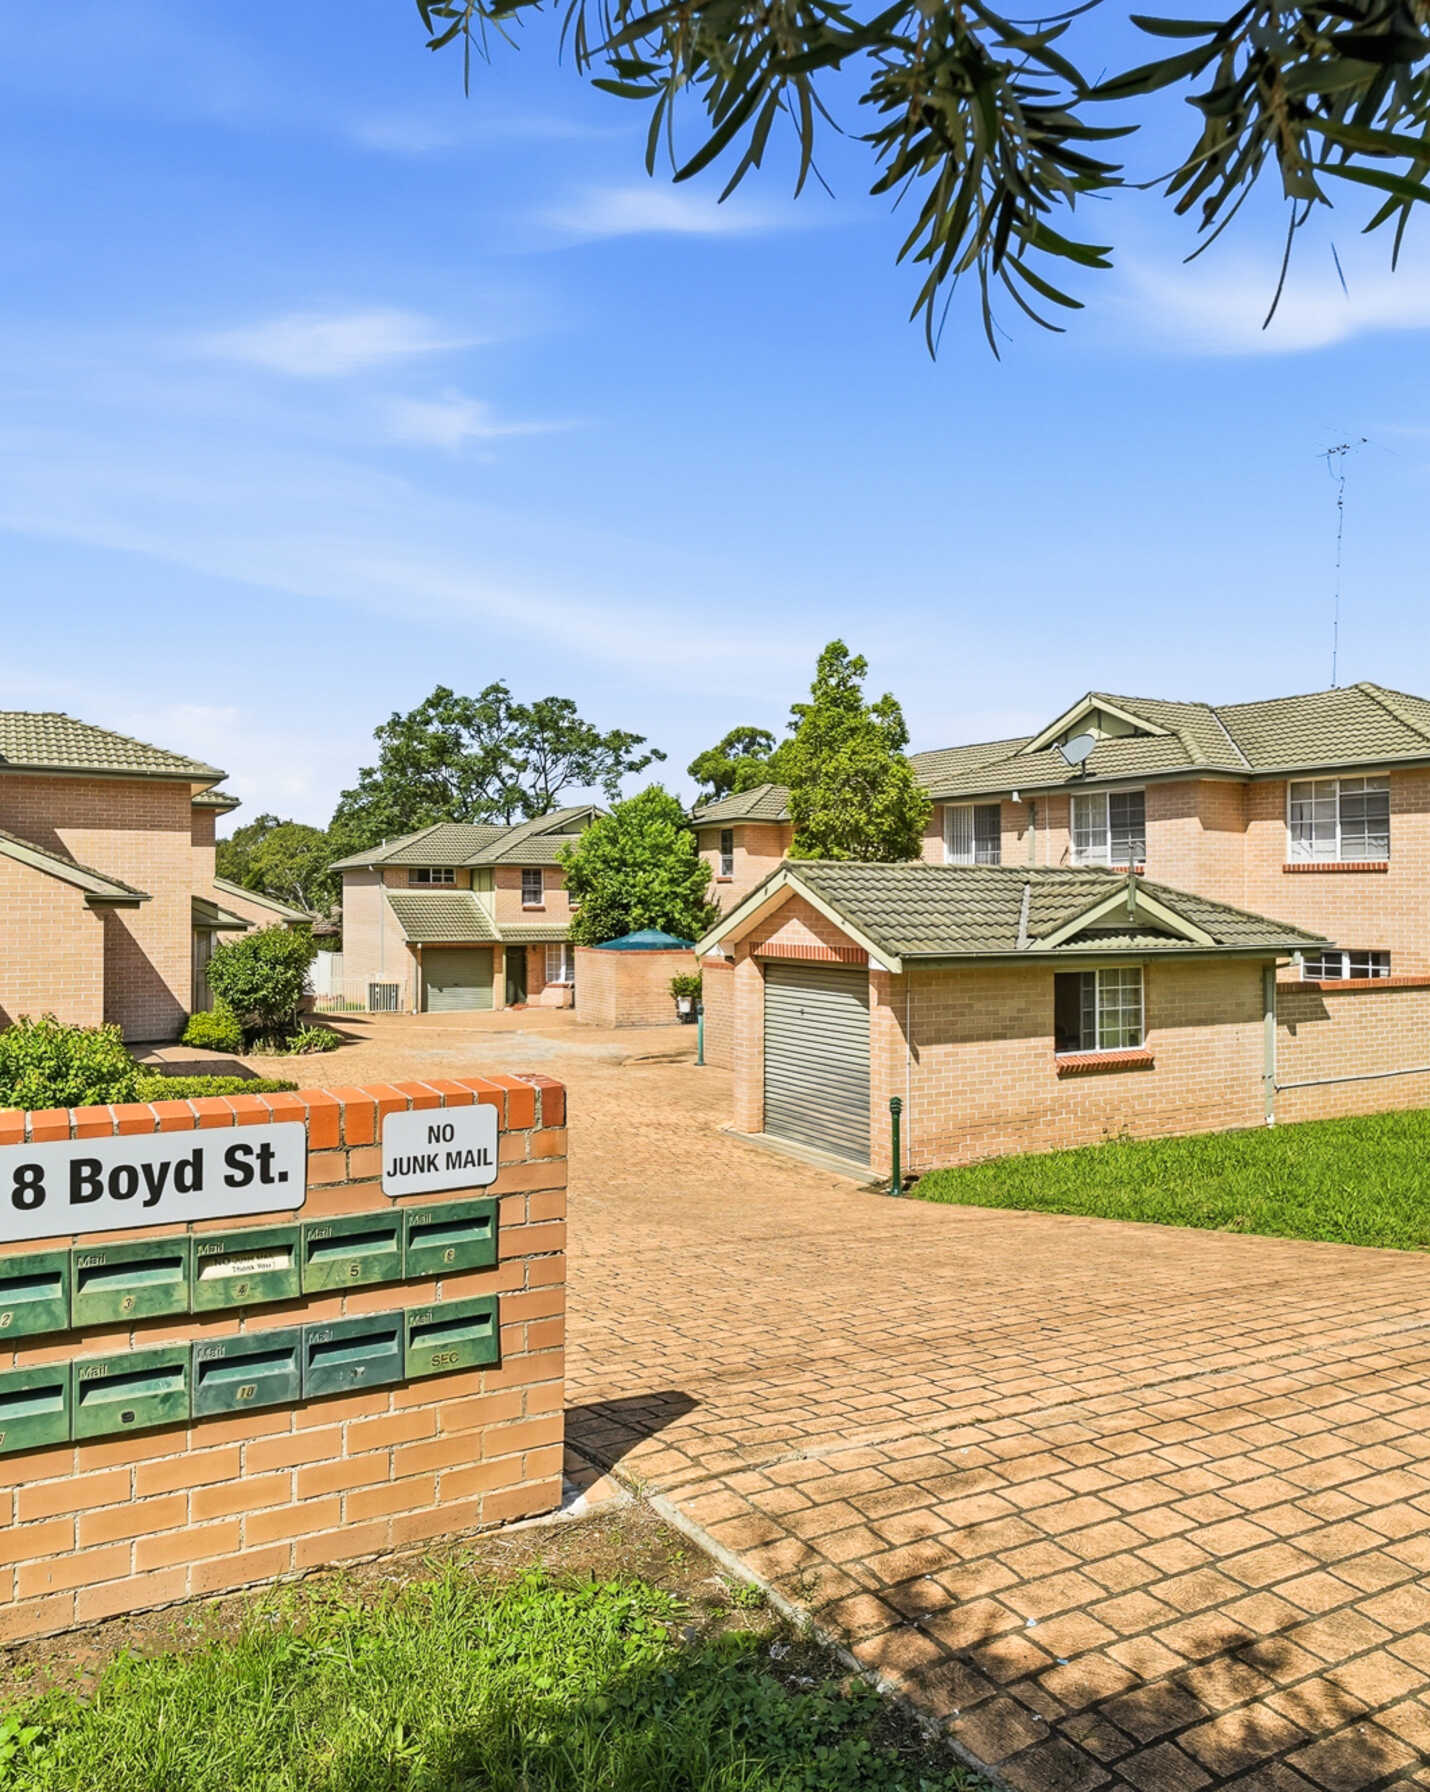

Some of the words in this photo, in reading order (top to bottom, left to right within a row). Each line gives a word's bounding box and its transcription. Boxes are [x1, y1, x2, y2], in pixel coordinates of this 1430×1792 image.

[427, 1123, 455, 1145] NO
[386, 1152, 440, 1178] JUNK
[445, 1147, 494, 1171] MAIL
[11, 1163, 46, 1211] 8
[69, 1147, 204, 1208] Boyd
[223, 1142, 290, 1189] St.
[408, 1213, 433, 1226] Mail
[307, 1226, 332, 1241] Mail
[197, 1241, 225, 1256] Mail
[77, 1254, 107, 1269] Mail
[350, 1264, 360, 1277] 5
[124, 1298, 133, 1310] 3
[1, 1314, 12, 1327] 2
[308, 1330, 334, 1344] Mail
[197, 1345, 225, 1361] Mail
[431, 1352, 459, 1367] SEC
[79, 1364, 108, 1379] Mail
